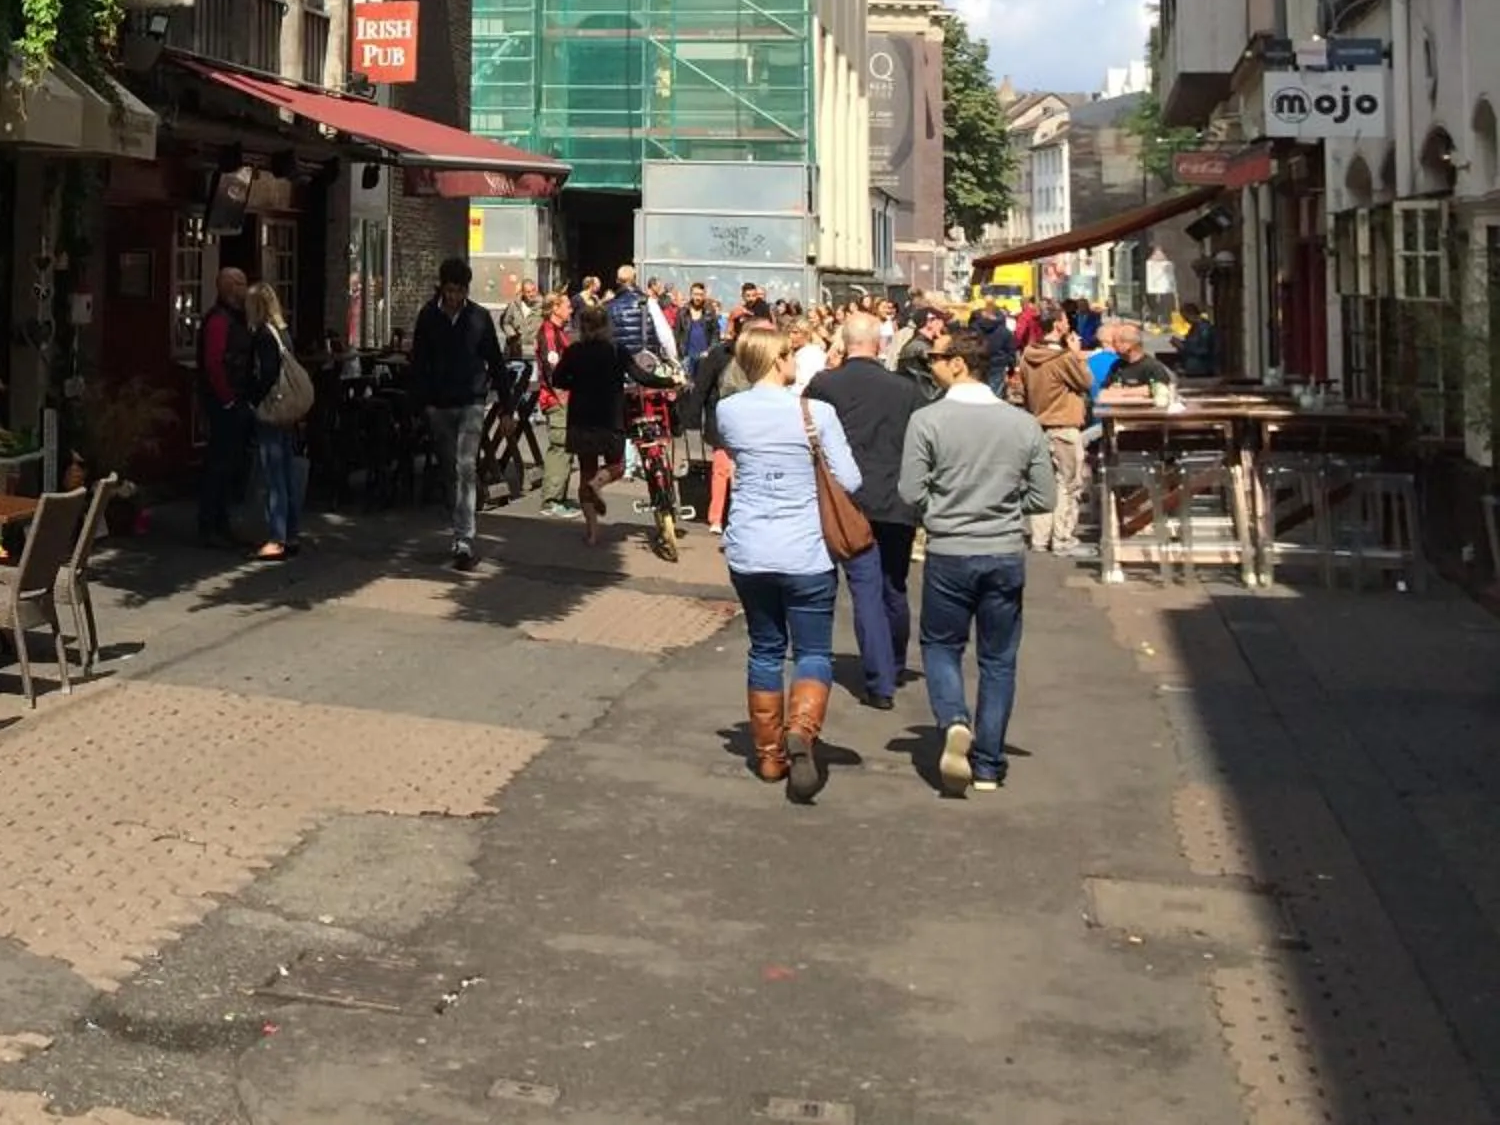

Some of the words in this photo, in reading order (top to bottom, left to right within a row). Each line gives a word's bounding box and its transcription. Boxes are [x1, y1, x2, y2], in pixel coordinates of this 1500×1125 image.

[356, 16, 413, 40] IRISH
[362, 43, 405, 68] PUB
[1272, 85, 1378, 124] mojo
